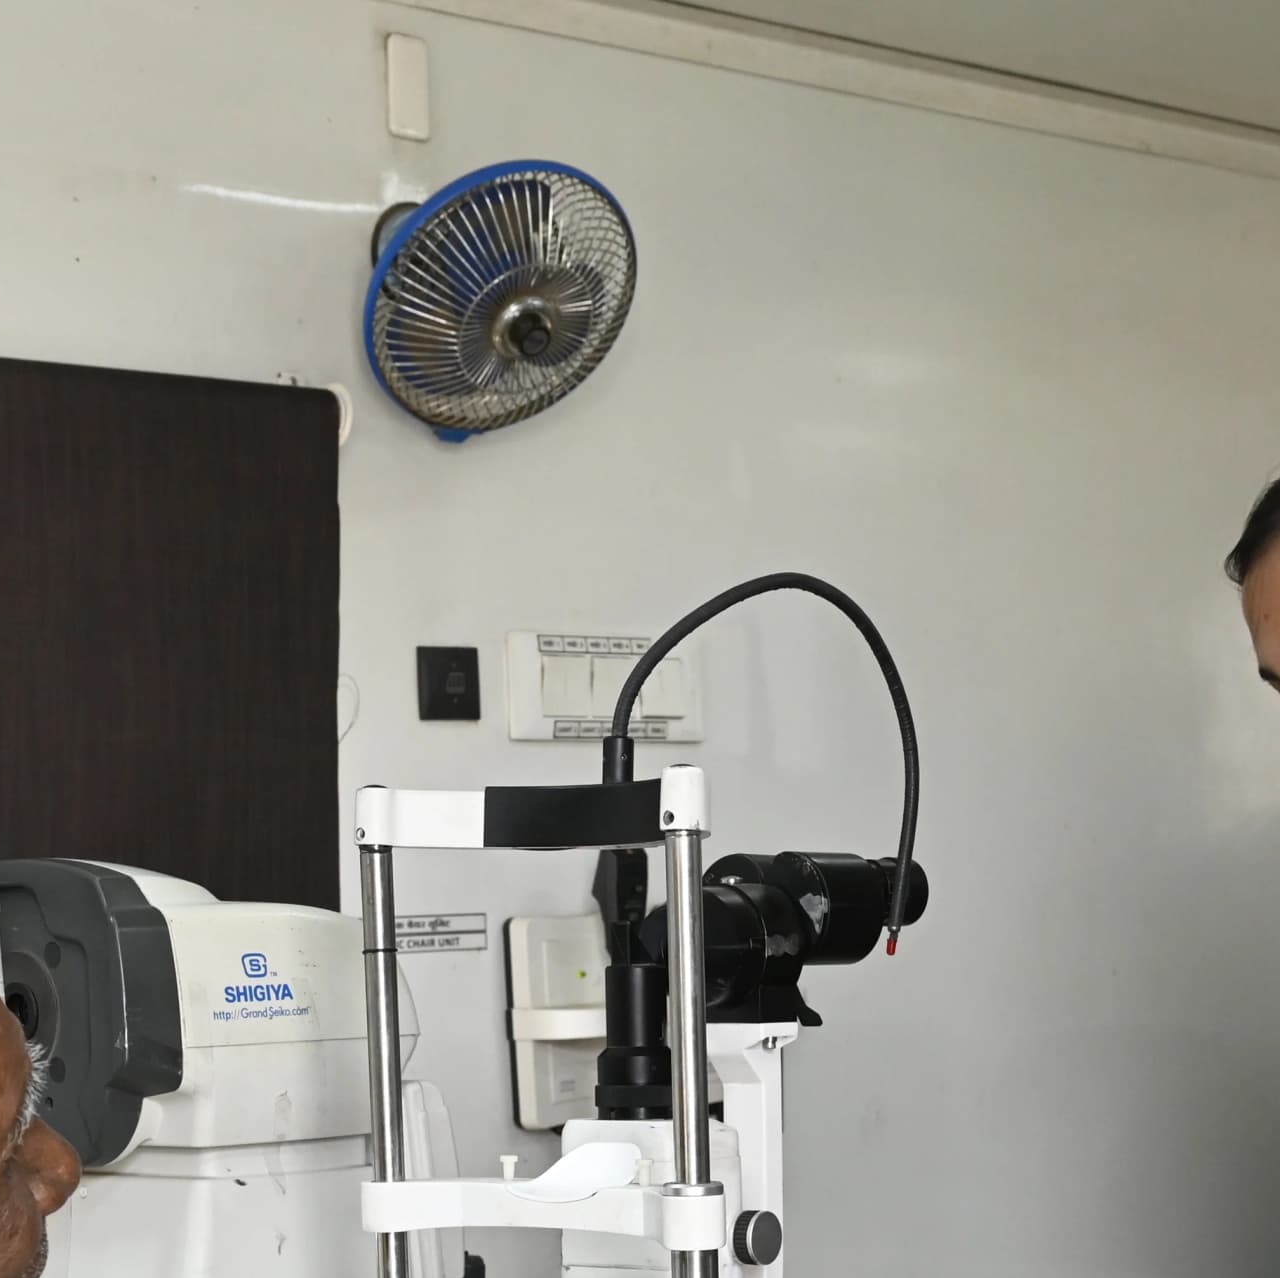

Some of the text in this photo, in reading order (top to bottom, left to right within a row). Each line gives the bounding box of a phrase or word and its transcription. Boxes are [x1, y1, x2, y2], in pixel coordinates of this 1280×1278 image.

[406, 938, 436, 949] CHAIR
[438, 936, 460, 947] UNIT
[224, 983, 294, 1003] SHIGIYA
